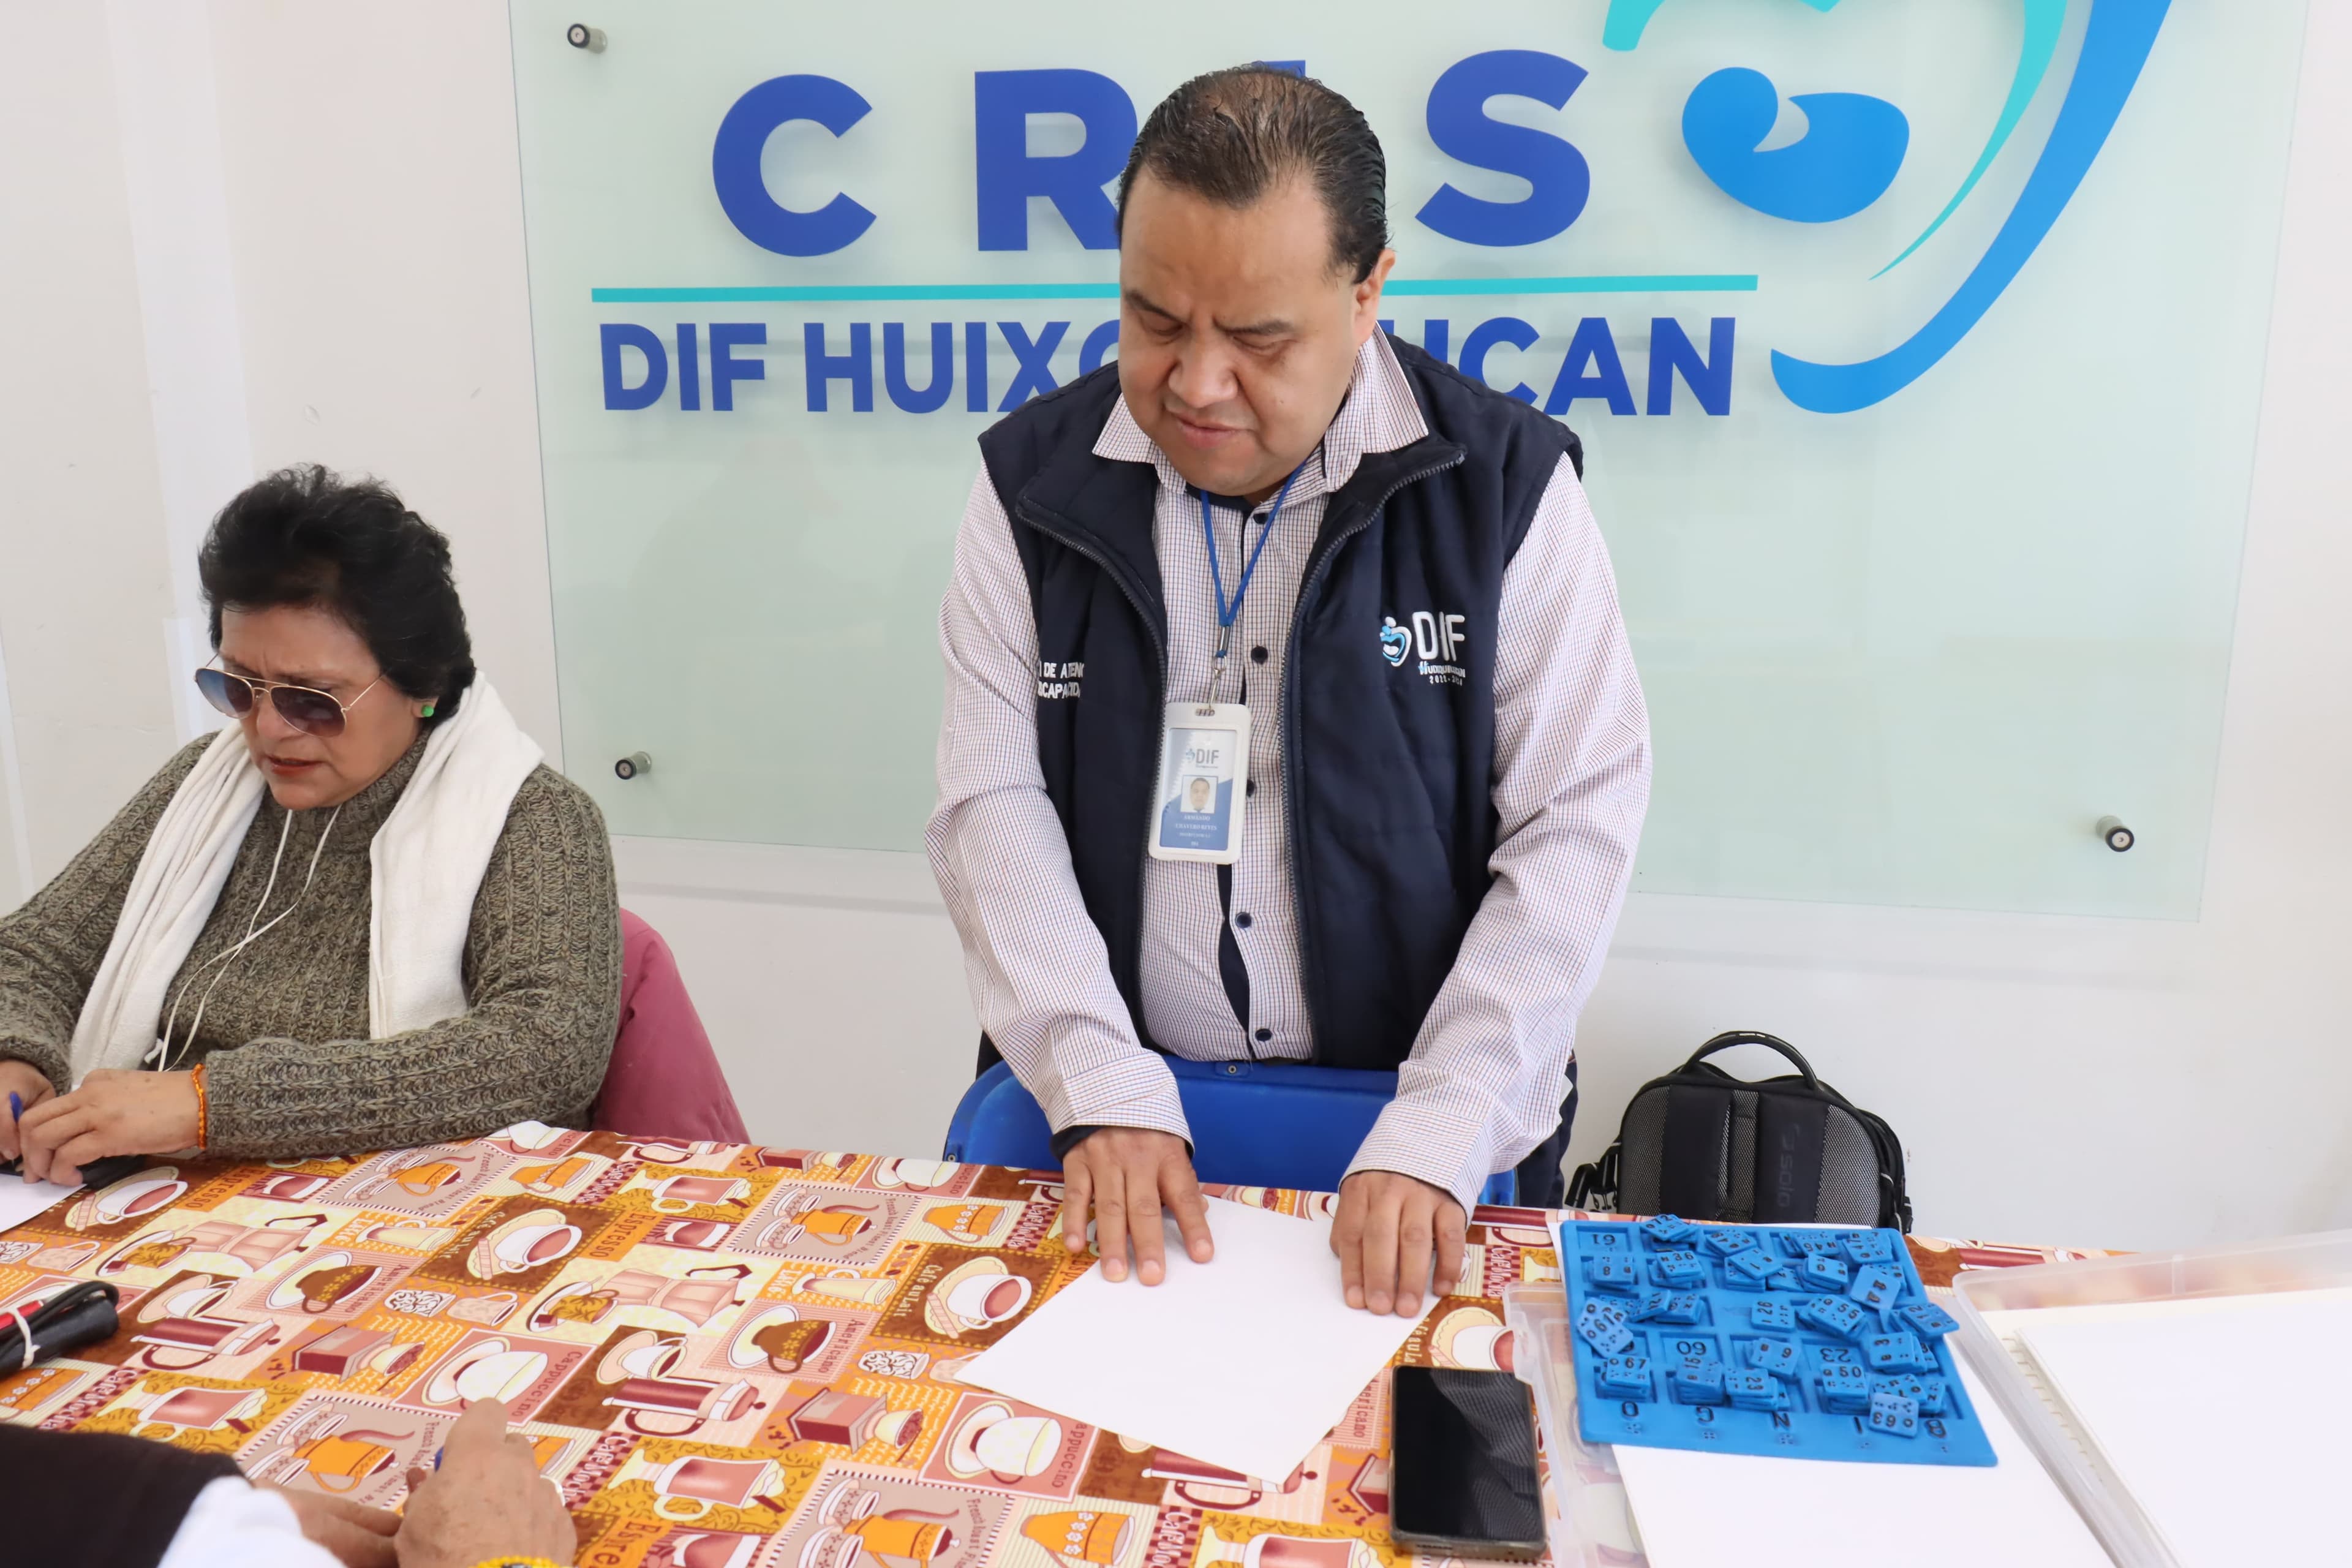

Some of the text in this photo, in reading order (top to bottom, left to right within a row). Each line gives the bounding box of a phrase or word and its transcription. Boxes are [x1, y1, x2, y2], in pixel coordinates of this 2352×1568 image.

[600, 323, 767, 411] DIF
[1412, 611, 1465, 662] DIF
[1044, 662, 1057, 678] DE
[1196, 748, 1219, 764] DIF
[1777, 1154, 1795, 1208] solo
[590, 1213, 657, 1259] Espresso
[1673, 1252, 1695, 1261] 36
[1602, 1265, 1611, 1276] 8
[344, 1264, 412, 1314] Americano
[1757, 1300, 1773, 1315] 26
[1838, 1303, 1860, 1319] 55
[1594, 1313, 1615, 1332] 61
[818, 1319, 865, 1373] Americano
[1625, 1357, 1648, 1370] 67
[1820, 1348, 1852, 1363] 23
[1839, 1366, 1862, 1378] 50
[512, 1351, 582, 1417] Cappuccino
[1621, 1401, 1947, 1438] B I N G O
[1872, 1411, 1896, 1428] 63
